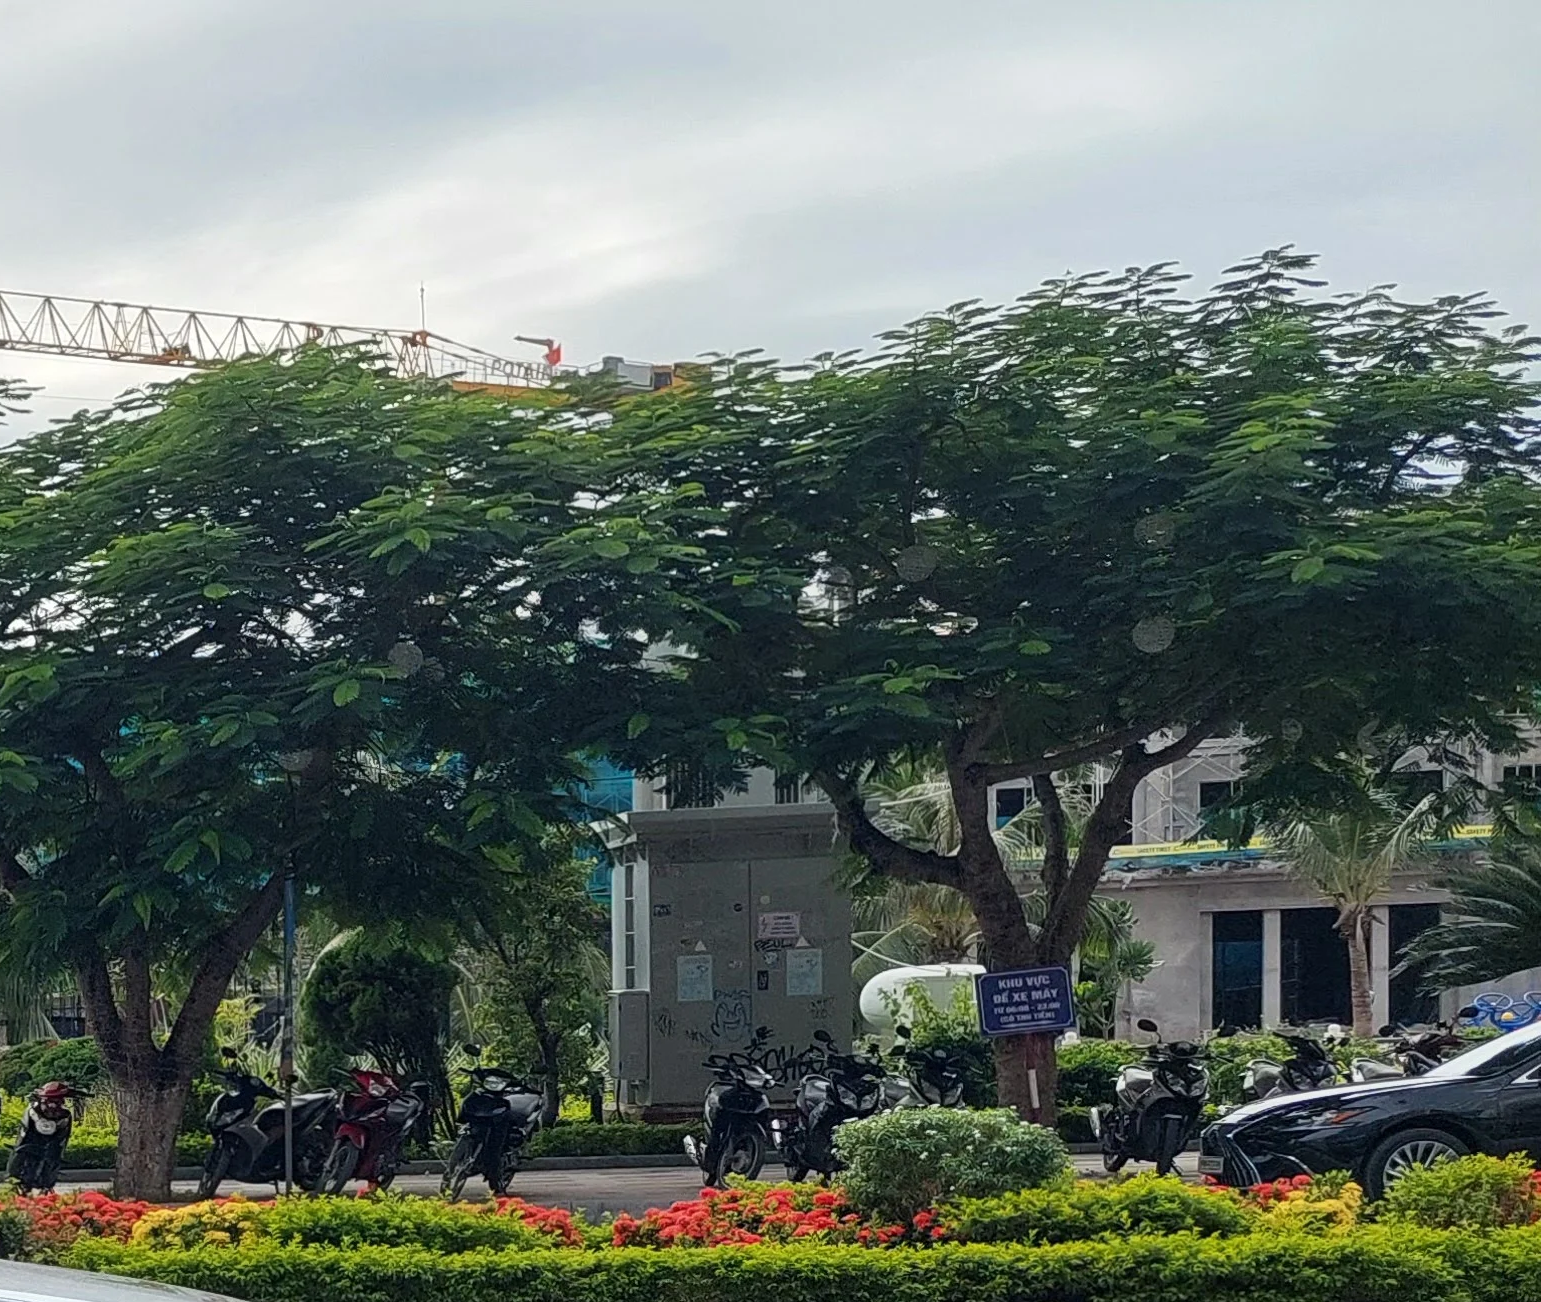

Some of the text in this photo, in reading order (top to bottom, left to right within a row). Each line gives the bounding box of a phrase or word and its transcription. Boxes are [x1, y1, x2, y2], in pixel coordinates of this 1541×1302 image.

[998, 975, 1051, 990] KHU VỰC
[1012, 991, 1029, 1003] XE
[1031, 988, 1058, 1000] MÁY
